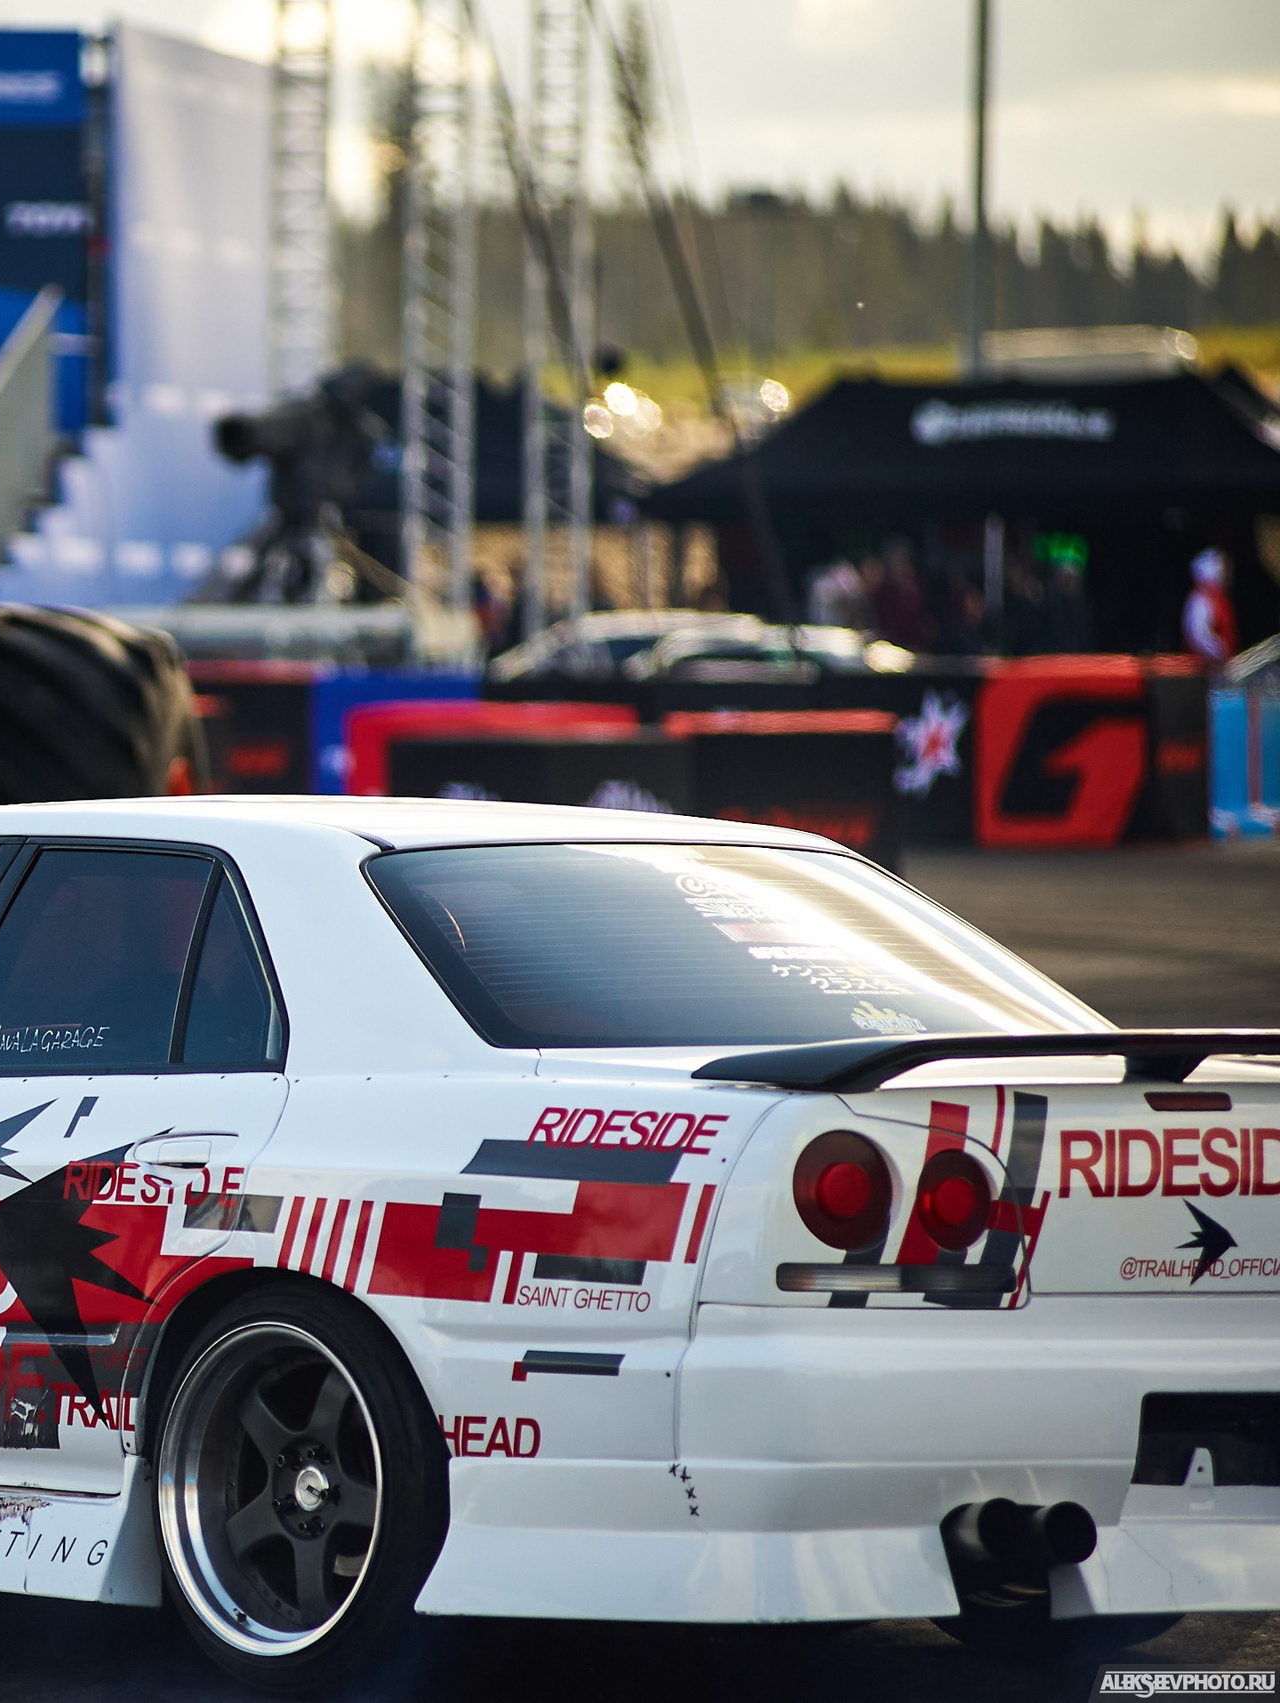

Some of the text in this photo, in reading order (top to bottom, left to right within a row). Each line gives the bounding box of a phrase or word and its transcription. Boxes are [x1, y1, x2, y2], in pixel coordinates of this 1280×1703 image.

[526, 1107, 729, 1155] RIDESIDE
[1120, 1256, 1280, 1281] @TRAILHEAD_OFFICI
[517, 1284, 651, 1312] SAINT GHETTO
[50, 1383, 136, 1431] TRAIL
[438, 1414, 542, 1458] HEAD
